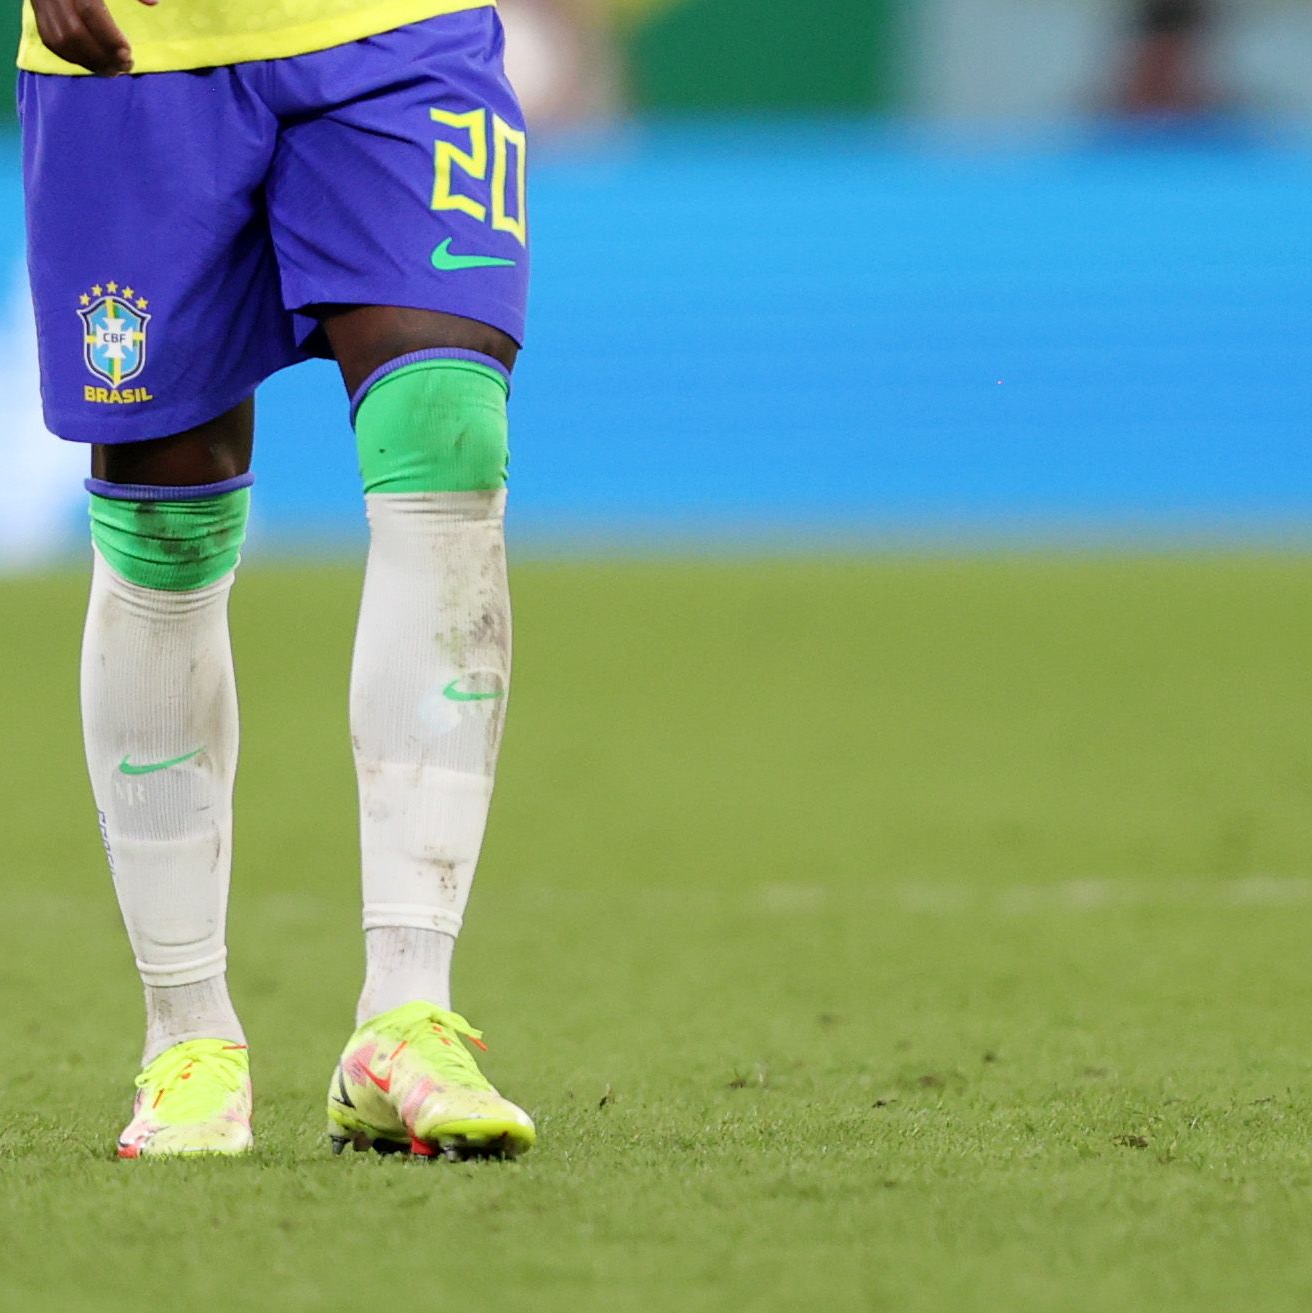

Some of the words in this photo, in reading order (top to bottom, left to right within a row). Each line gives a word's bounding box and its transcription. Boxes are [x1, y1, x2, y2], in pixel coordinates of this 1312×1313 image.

[429, 106, 527, 249] 20
[102, 332, 126, 344] CBF
[84, 384, 153, 404] BRASIL
